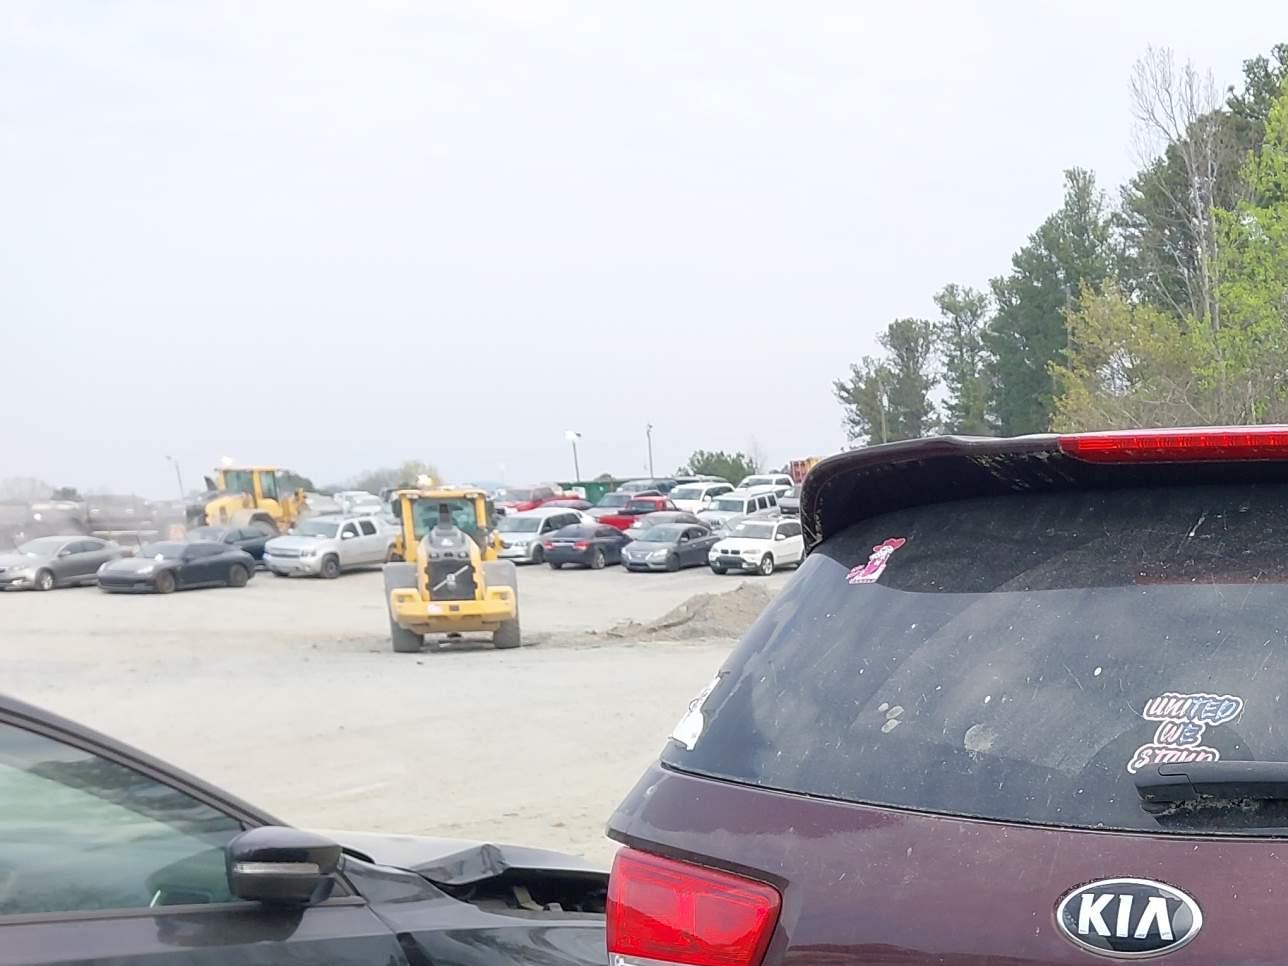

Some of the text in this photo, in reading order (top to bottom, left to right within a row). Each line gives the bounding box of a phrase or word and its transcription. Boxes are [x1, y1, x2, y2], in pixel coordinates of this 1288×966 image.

[1147, 696, 1238, 721] UNITED
[1159, 722, 1201, 745] WE
[1077, 893, 1174, 941] KIA
